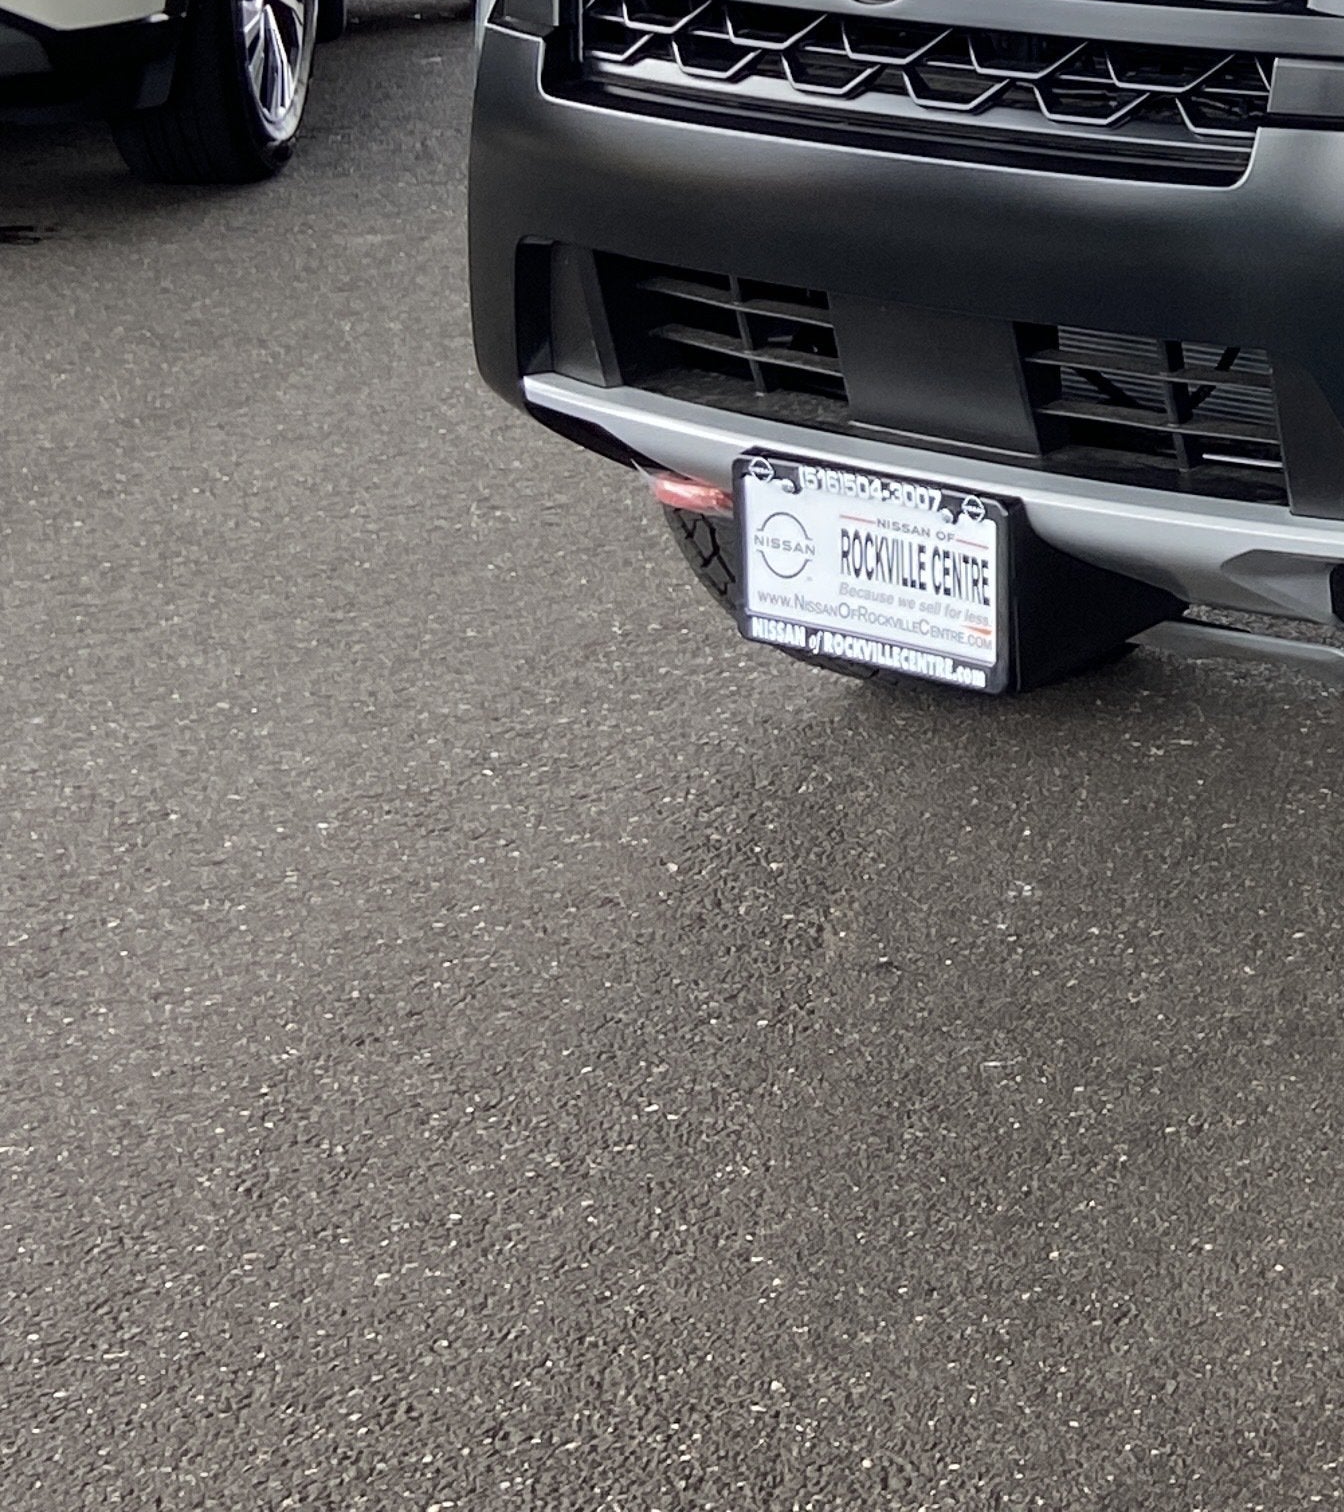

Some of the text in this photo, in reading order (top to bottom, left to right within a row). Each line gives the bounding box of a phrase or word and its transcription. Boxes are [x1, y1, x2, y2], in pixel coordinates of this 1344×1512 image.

[877, 518, 955, 542] NISSAN OF
[754, 534, 816, 556] NISSAN
[841, 528, 990, 606] ROCKVILLE CENTRE
[839, 582, 894, 605] Because
[752, 616, 806, 648] NISSAN
[808, 630, 823, 655] of
